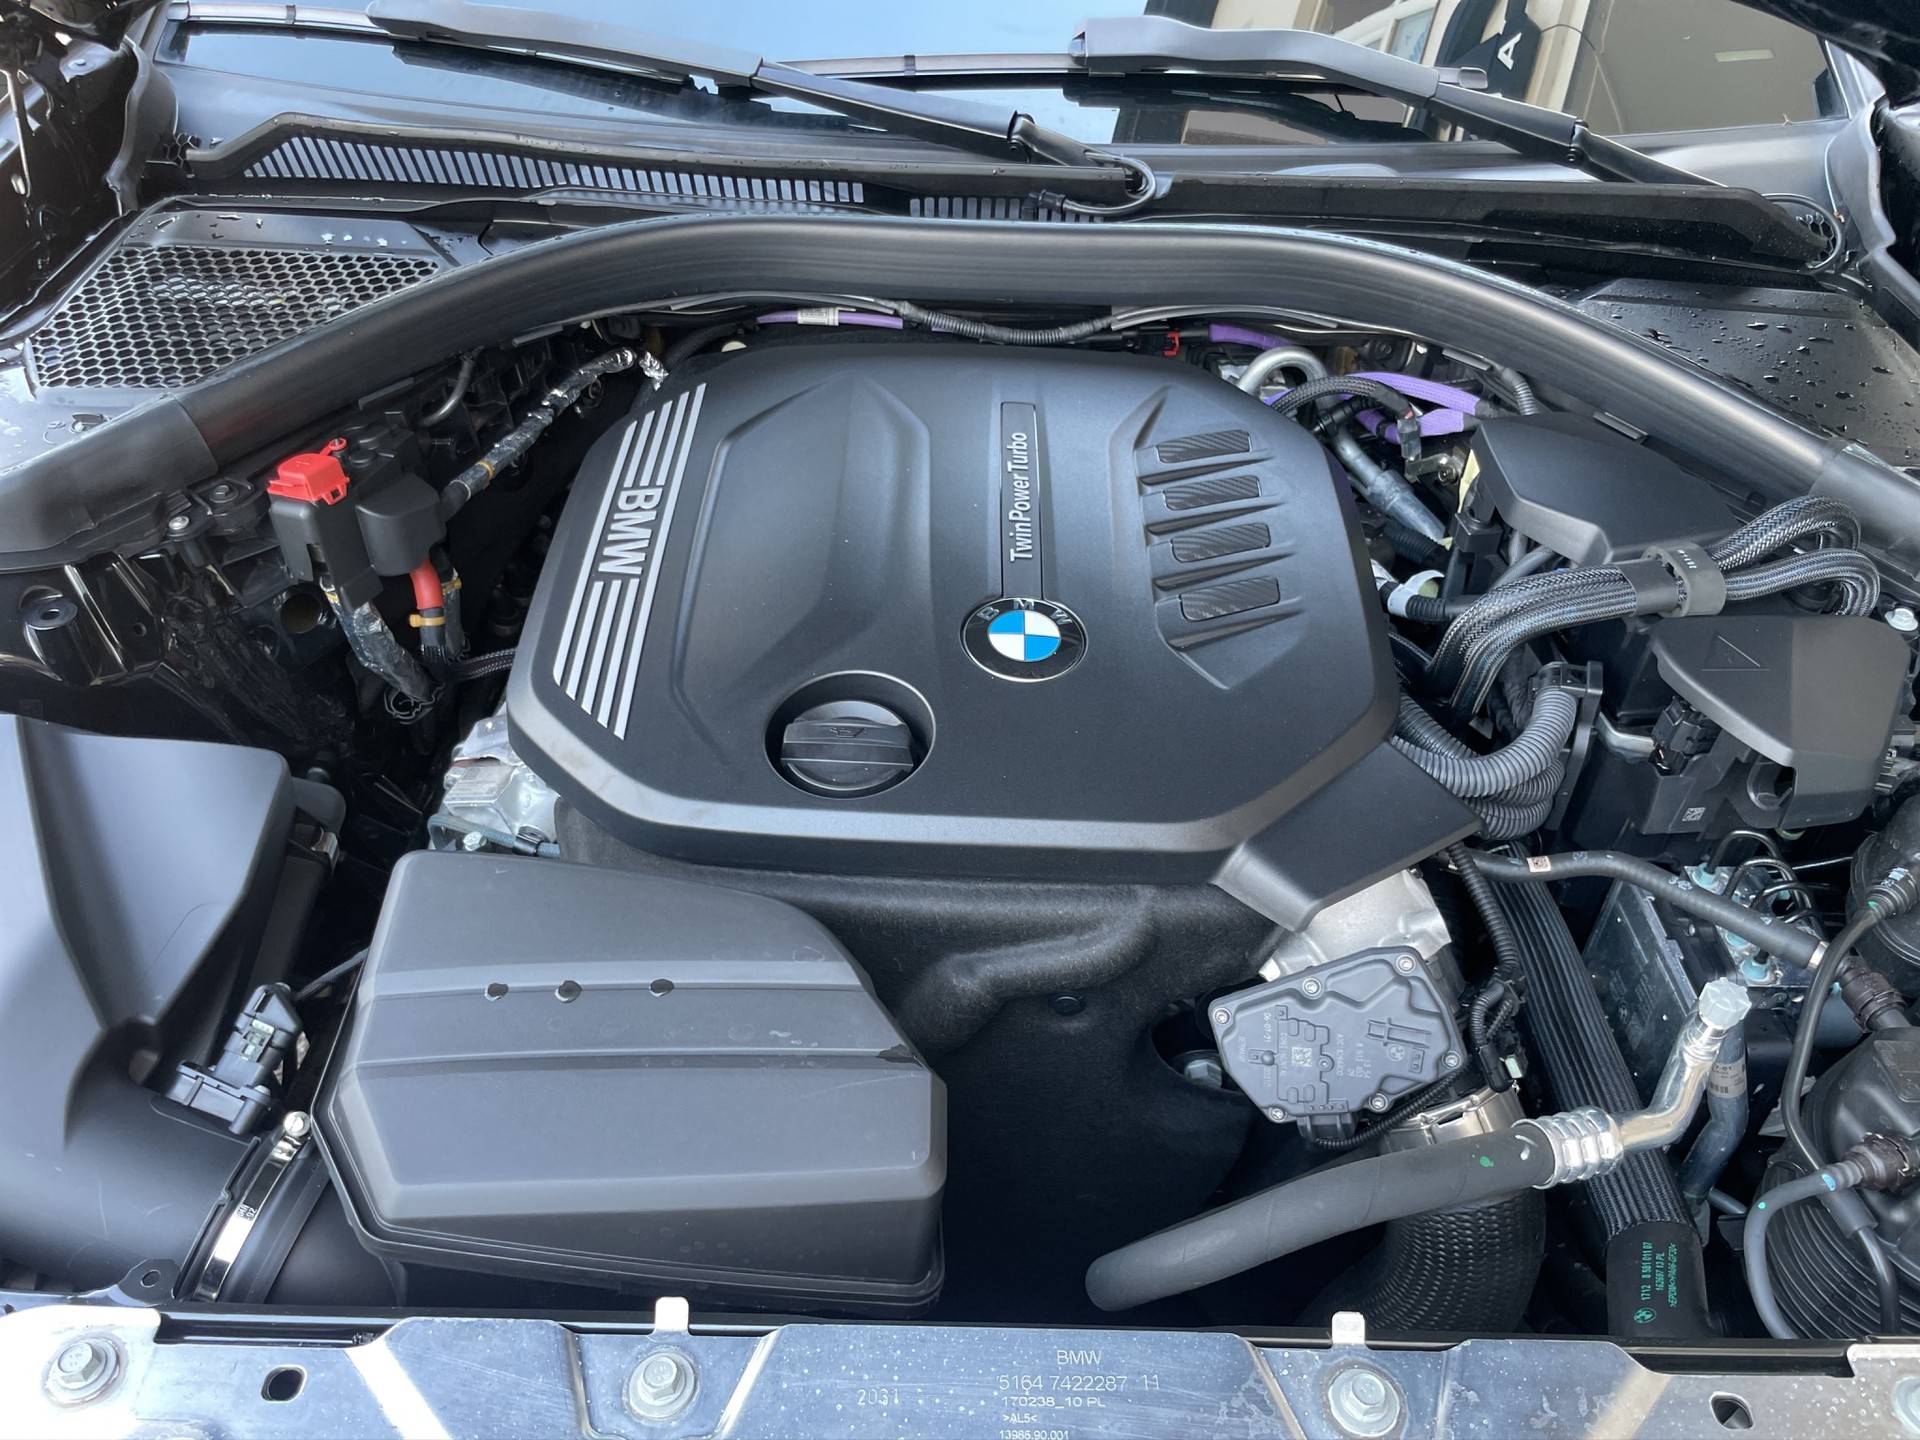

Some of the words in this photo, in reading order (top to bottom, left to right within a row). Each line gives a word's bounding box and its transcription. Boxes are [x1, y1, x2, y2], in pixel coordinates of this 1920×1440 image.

[1006, 432, 1029, 473] Turbo
[1008, 473, 1033, 562] TwinPower
[597, 485, 664, 576] BMW
[977, 599, 1073, 625] BMW
[1237, 1035, 1246, 1063] GERMANY
[1641, 1284, 1651, 1300] 1712
[1057, 1350, 1102, 1366] BMW
[999, 1375, 1044, 1390] 5164
[1049, 1375, 1128, 1391] 7422287
[1087, 1397, 1106, 1408] PL
[1002, 1413, 1037, 1424] >AL5<
